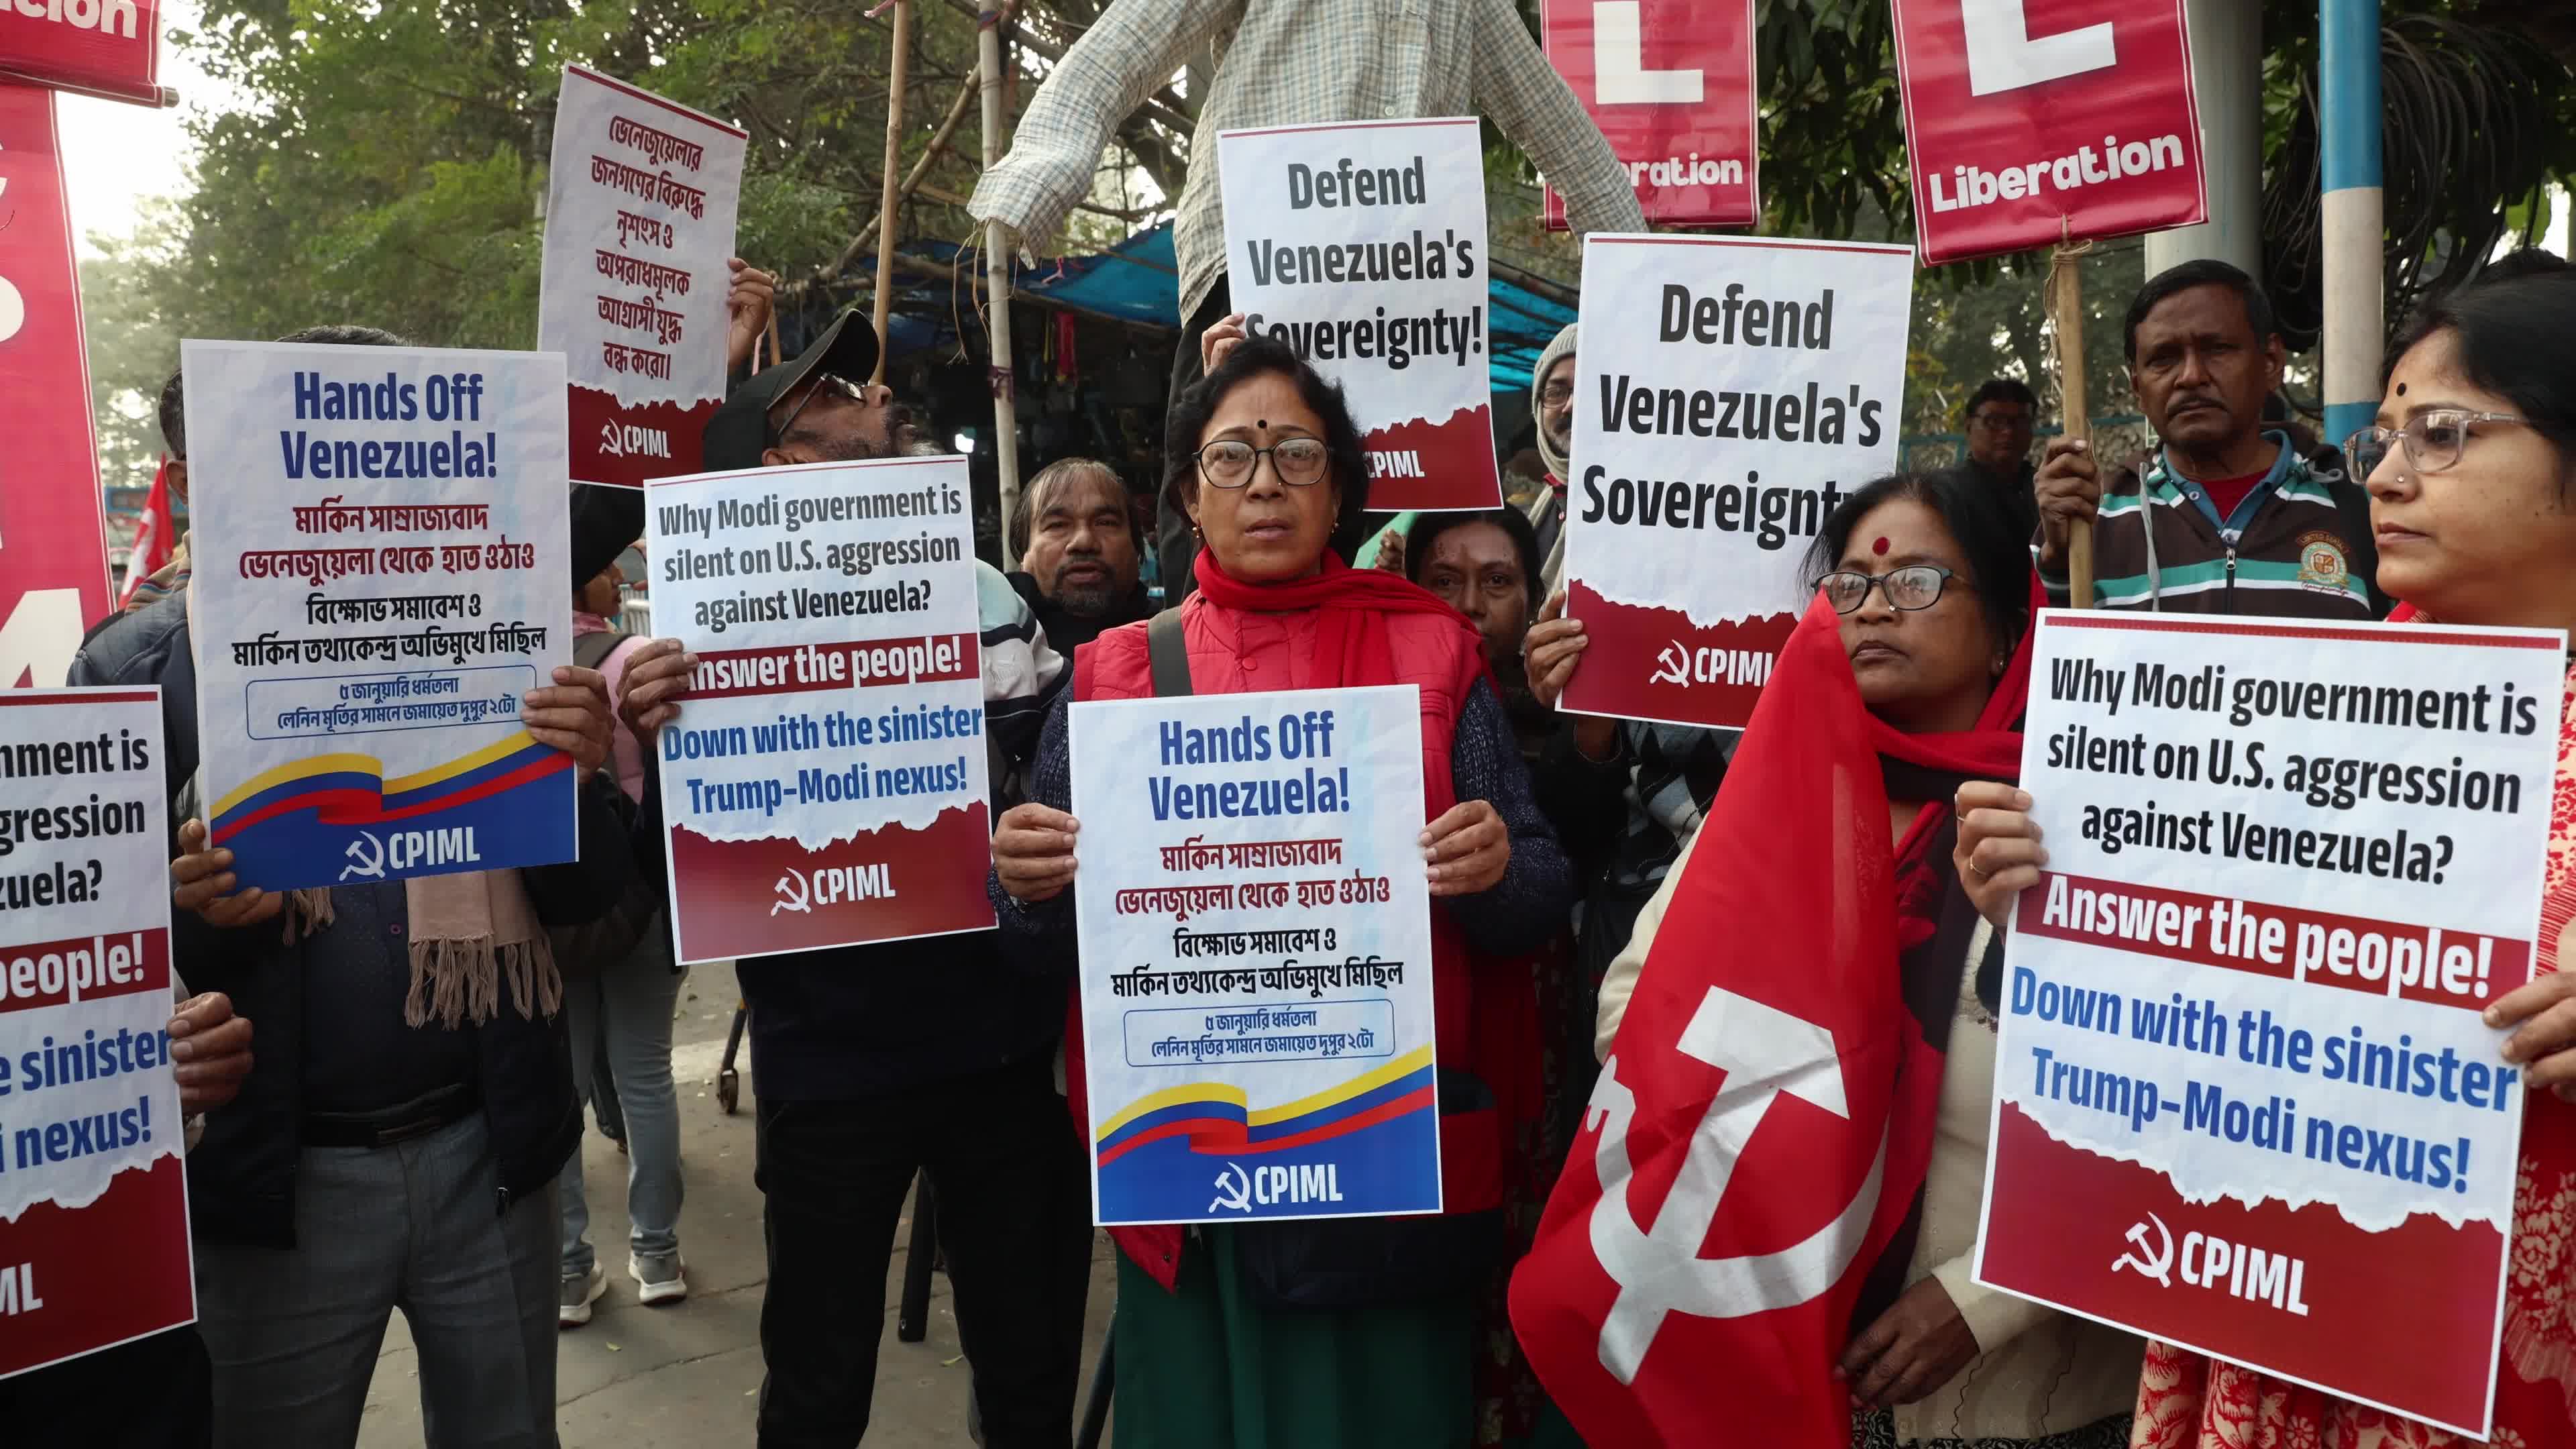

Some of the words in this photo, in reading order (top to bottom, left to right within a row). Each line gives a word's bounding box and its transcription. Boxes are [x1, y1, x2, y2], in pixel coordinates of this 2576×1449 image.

[609, 115, 704, 172] ভেনেজুয়েলার
[592, 155, 656, 202] জনগণের
[657, 170, 706, 220] বিরুদ্ধে
[1287, 156, 1426, 210] Defend
[1929, 133, 2185, 215] Liberation
[617, 209, 661, 249] নৃশংস
[663, 225, 673, 249] ও
[596, 250, 691, 303] অপরাধমূলক
[1247, 229, 1474, 286] Venezuela's
[597, 294, 655, 340] আগ্রাসী
[657, 309, 684, 345] যুদ্ধ
[1660, 282, 1834, 350] Defend
[604, 341, 630, 374] বন্ধ
[294, 372, 418, 421] Hands
[425, 373, 483, 421] Off
[1600, 374, 1882, 447] Venezuela's
[280, 431, 497, 479] Venezuela!
[623, 425, 672, 458] CPIML
[292, 495, 364, 533] মার্কিন
[369, 504, 488, 533] সাম্রাজ্যবাদ
[659, 502, 712, 538] Why
[717, 493, 780, 529] Modi
[785, 489, 937, 532] government
[941, 482, 962, 515] is
[1582, 464, 1854, 550] Sovereignt
[239, 547, 375, 586] ভেনেজুয়েলা
[379, 546, 434, 574] থেকে
[441, 544, 480, 575] হাত
[485, 535, 535, 570] ওঠাও
[664, 548, 737, 582] silent
[739, 547, 772, 572] on
[776, 539, 822, 572] U.S.
[826, 530, 961, 576] aggression
[306, 592, 387, 625] বিক্ষোভ
[390, 594, 464, 621] সমাবেশ
[469, 594, 481, 617] ও
[695, 590, 788, 633] against
[792, 579, 931, 619] Venezuela?
[232, 631, 299, 666] মার্কিন
[304, 635, 396, 662] তথ্যকেন্দ্র
[399, 627, 486, 665] অভিমুখে
[488, 622, 547, 655] মিছিল
[794, 645, 849, 682] the
[852, 636, 961, 688] people!
[278, 707, 320, 729] লেনিন
[323, 703, 360, 732] মূর্তির
[361, 704, 400, 723] সামনে
[402, 701, 458, 720] জমায়েত
[460, 699, 487, 722] দুপুর
[489, 694, 516, 715] ২টো
[352, 676, 409, 704] জানুয়ারি
[412, 673, 459, 696] ধর্মতলা
[2051, 657, 2126, 716] Why
[2132, 663, 2226, 714] Modi
[2230, 676, 2491, 733] government
[2500, 682, 2538, 737] is
[121, 728, 149, 771] is
[663, 724, 747, 763] Down
[751, 714, 819, 757] with
[822, 710, 872, 749] the
[877, 704, 982, 744] sinister
[1159, 716, 1271, 765] Hands
[1279, 710, 1334, 760] Off
[875, 757, 967, 798] nexus!
[1148, 767, 1349, 821] Venezuela!
[2047, 725, 2147, 777] silent
[2153, 742, 2200, 783] on
[2207, 739, 2275, 792] U.S.
[2283, 753, 2521, 814] aggression
[389, 826, 480, 869] CPIML
[1160, 835, 1225, 872] মার্কিন
[1226, 838, 1342, 869] সাম্রাজ্যবাদ
[2081, 803, 2214, 855] against
[2221, 811, 2454, 886] Venezuela?
[0, 859, 103, 911] uela?
[814, 863, 896, 905] CPIML
[1116, 885, 1234, 921] ভেনেজুয়েলা
[1238, 881, 1289, 909] থেকে
[1296, 879, 1336, 909] হাত
[1340, 869, 1390, 904] ওঠাও
[1173, 927, 1246, 958] বিক্ষোভ
[1250, 929, 1320, 955] সমাবেশ
[1324, 928, 1337, 951] ও
[2042, 875, 2203, 950] Answer
[2208, 899, 2285, 965] the
[2293, 922, 2493, 999] people!
[0, 933, 145, 1004] eople!
[1111, 964, 1169, 998] মার্কিন
[1172, 969, 1258, 994] তথ্যকেন্দ্র
[1260, 961, 1343, 998] অভিমুখে
[1344, 955, 1404, 989] মিছিল
[1152, 1036, 1190, 1057] লেনিন
[1191, 1034, 1224, 1062] মূর্তির
[1226, 1037, 1262, 1055] সামনে
[1264, 1034, 1318, 1053] জমায়েত
[1319, 1032, 1345, 1056] দুপুর
[1348, 1028, 1374, 1049] ২টো
[1216, 1008, 1270, 1035] জানুয়ারি
[1272, 1006, 1317, 1027] ধর্মতলা
[2011, 966, 2121, 1035] Down
[2131, 992, 2229, 1057] with
[2237, 1008, 2314, 1075] the
[2322, 1026, 2518, 1113] sinister
[15, 1095, 152, 1169] nexus!
[2305, 1116, 2471, 1194] nexus!
[1254, 1164, 1342, 1204] CPIML
[2180, 1230, 2309, 1317] CPIML
